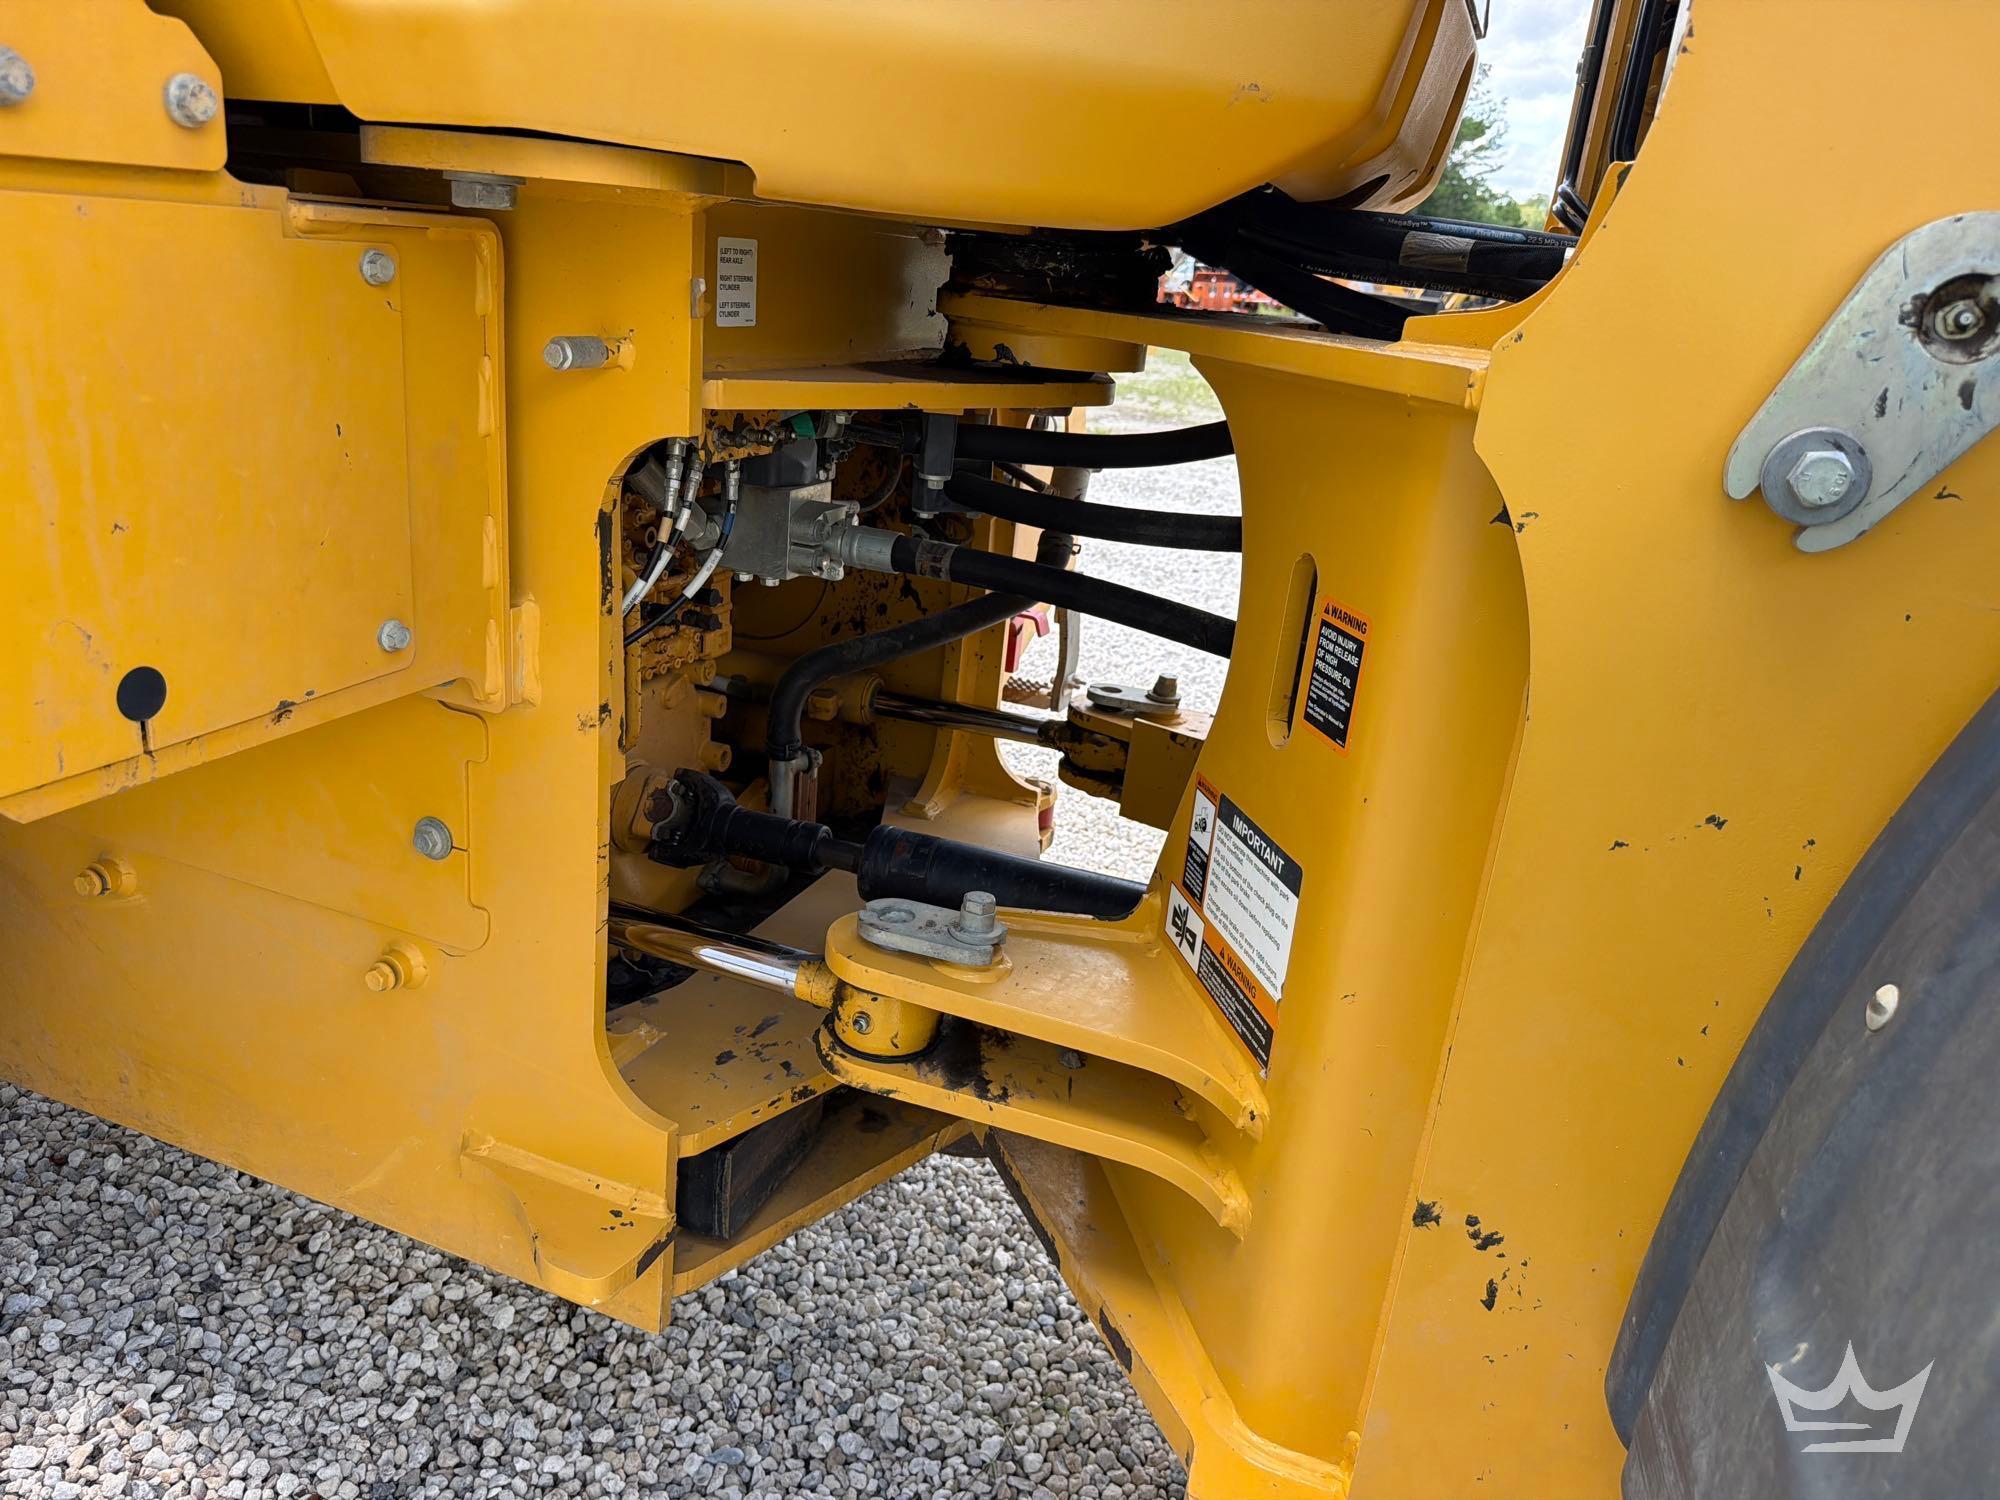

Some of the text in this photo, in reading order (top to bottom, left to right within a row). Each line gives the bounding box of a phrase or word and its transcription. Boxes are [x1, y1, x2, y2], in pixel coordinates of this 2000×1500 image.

[1528, 236, 1543, 244] 22.5
[1331, 604, 1368, 635] WARNING
[1318, 636, 1359, 667] FROM RELEASE
[1321, 624, 1357, 653] AVOID INJURY
[1315, 658, 1351, 688] PRESSURE OIL
[1317, 647, 1337, 667] OF HIGH
[1232, 813, 1284, 876] IMPORTANT
[1224, 830, 1232, 844] NOT
[1253, 860, 1270, 882] machine
[1270, 877, 1279, 892] with
[1279, 887, 1289, 903] park
[1230, 874, 1239, 889] park
[1229, 862, 1242, 880] bottom
[1253, 888, 1264, 905] check
[1265, 900, 1274, 916] plug
[1220, 879, 1233, 896] excess
[1238, 897, 1248, 913] down
[1248, 908, 1261, 927] before
[1261, 922, 1280, 950] replacing
[1228, 917, 1238, 934] brake
[1244, 936, 1255, 954] every
[1228, 927, 1238, 944] hours
[1243, 947, 1255, 964] severe
[1227, 953, 1256, 1000] WARNING
